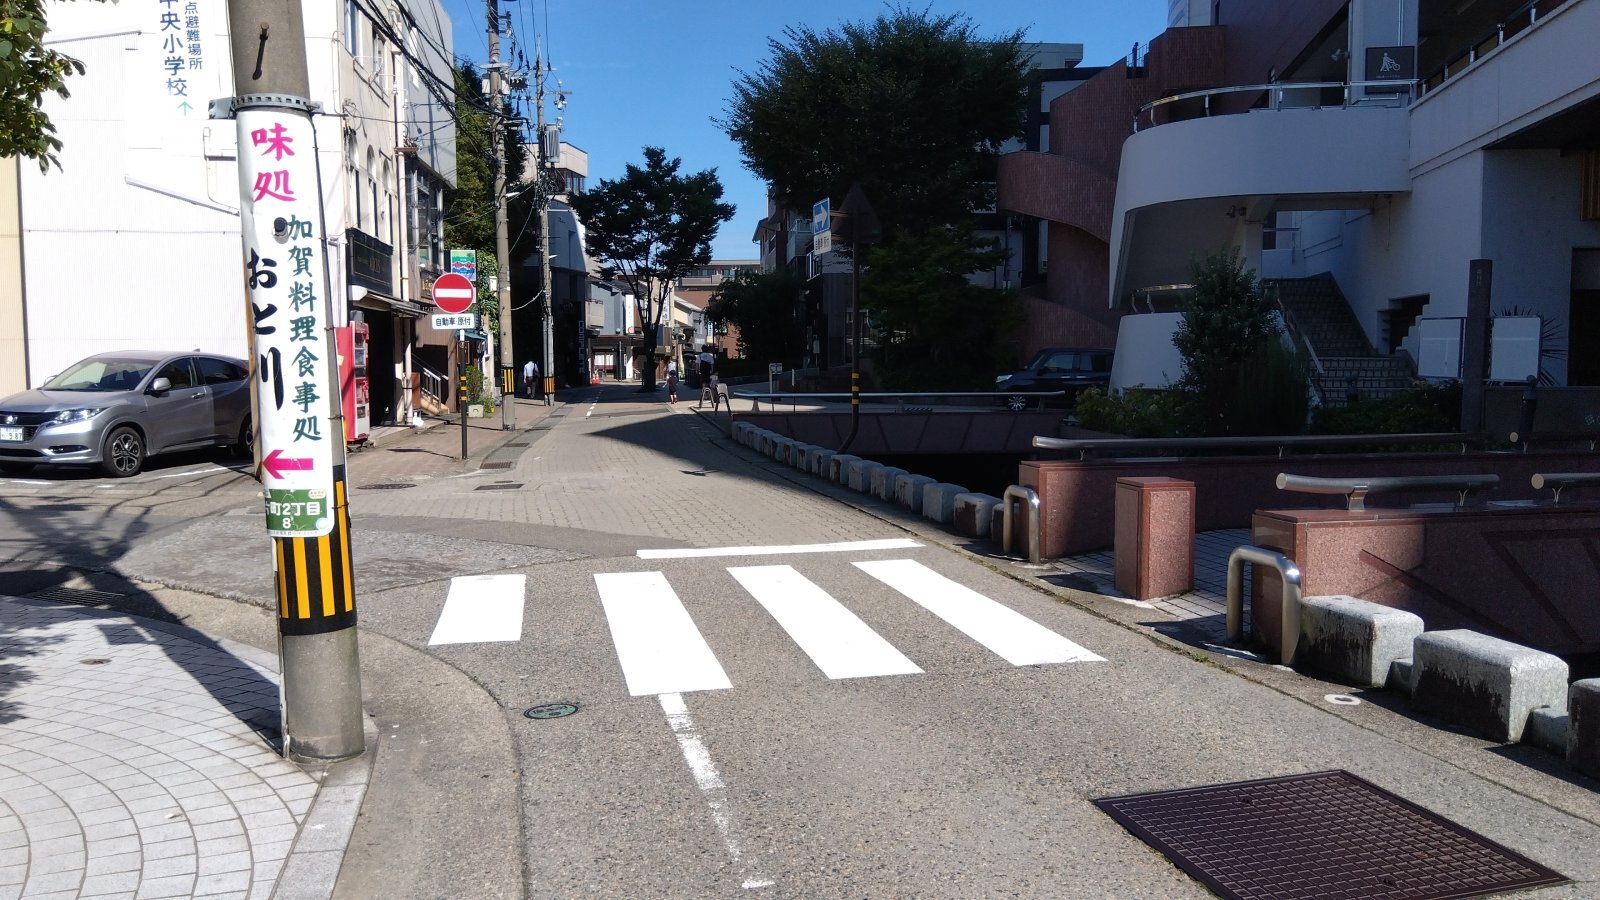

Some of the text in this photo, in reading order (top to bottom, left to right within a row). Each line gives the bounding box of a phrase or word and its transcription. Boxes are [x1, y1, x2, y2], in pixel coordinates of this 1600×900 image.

[251, 123, 297, 202] 味処
[247, 248, 284, 411] おとり
[288, 214, 322, 442] 加賀料理食事処
[282, 517, 291, 529] 8
